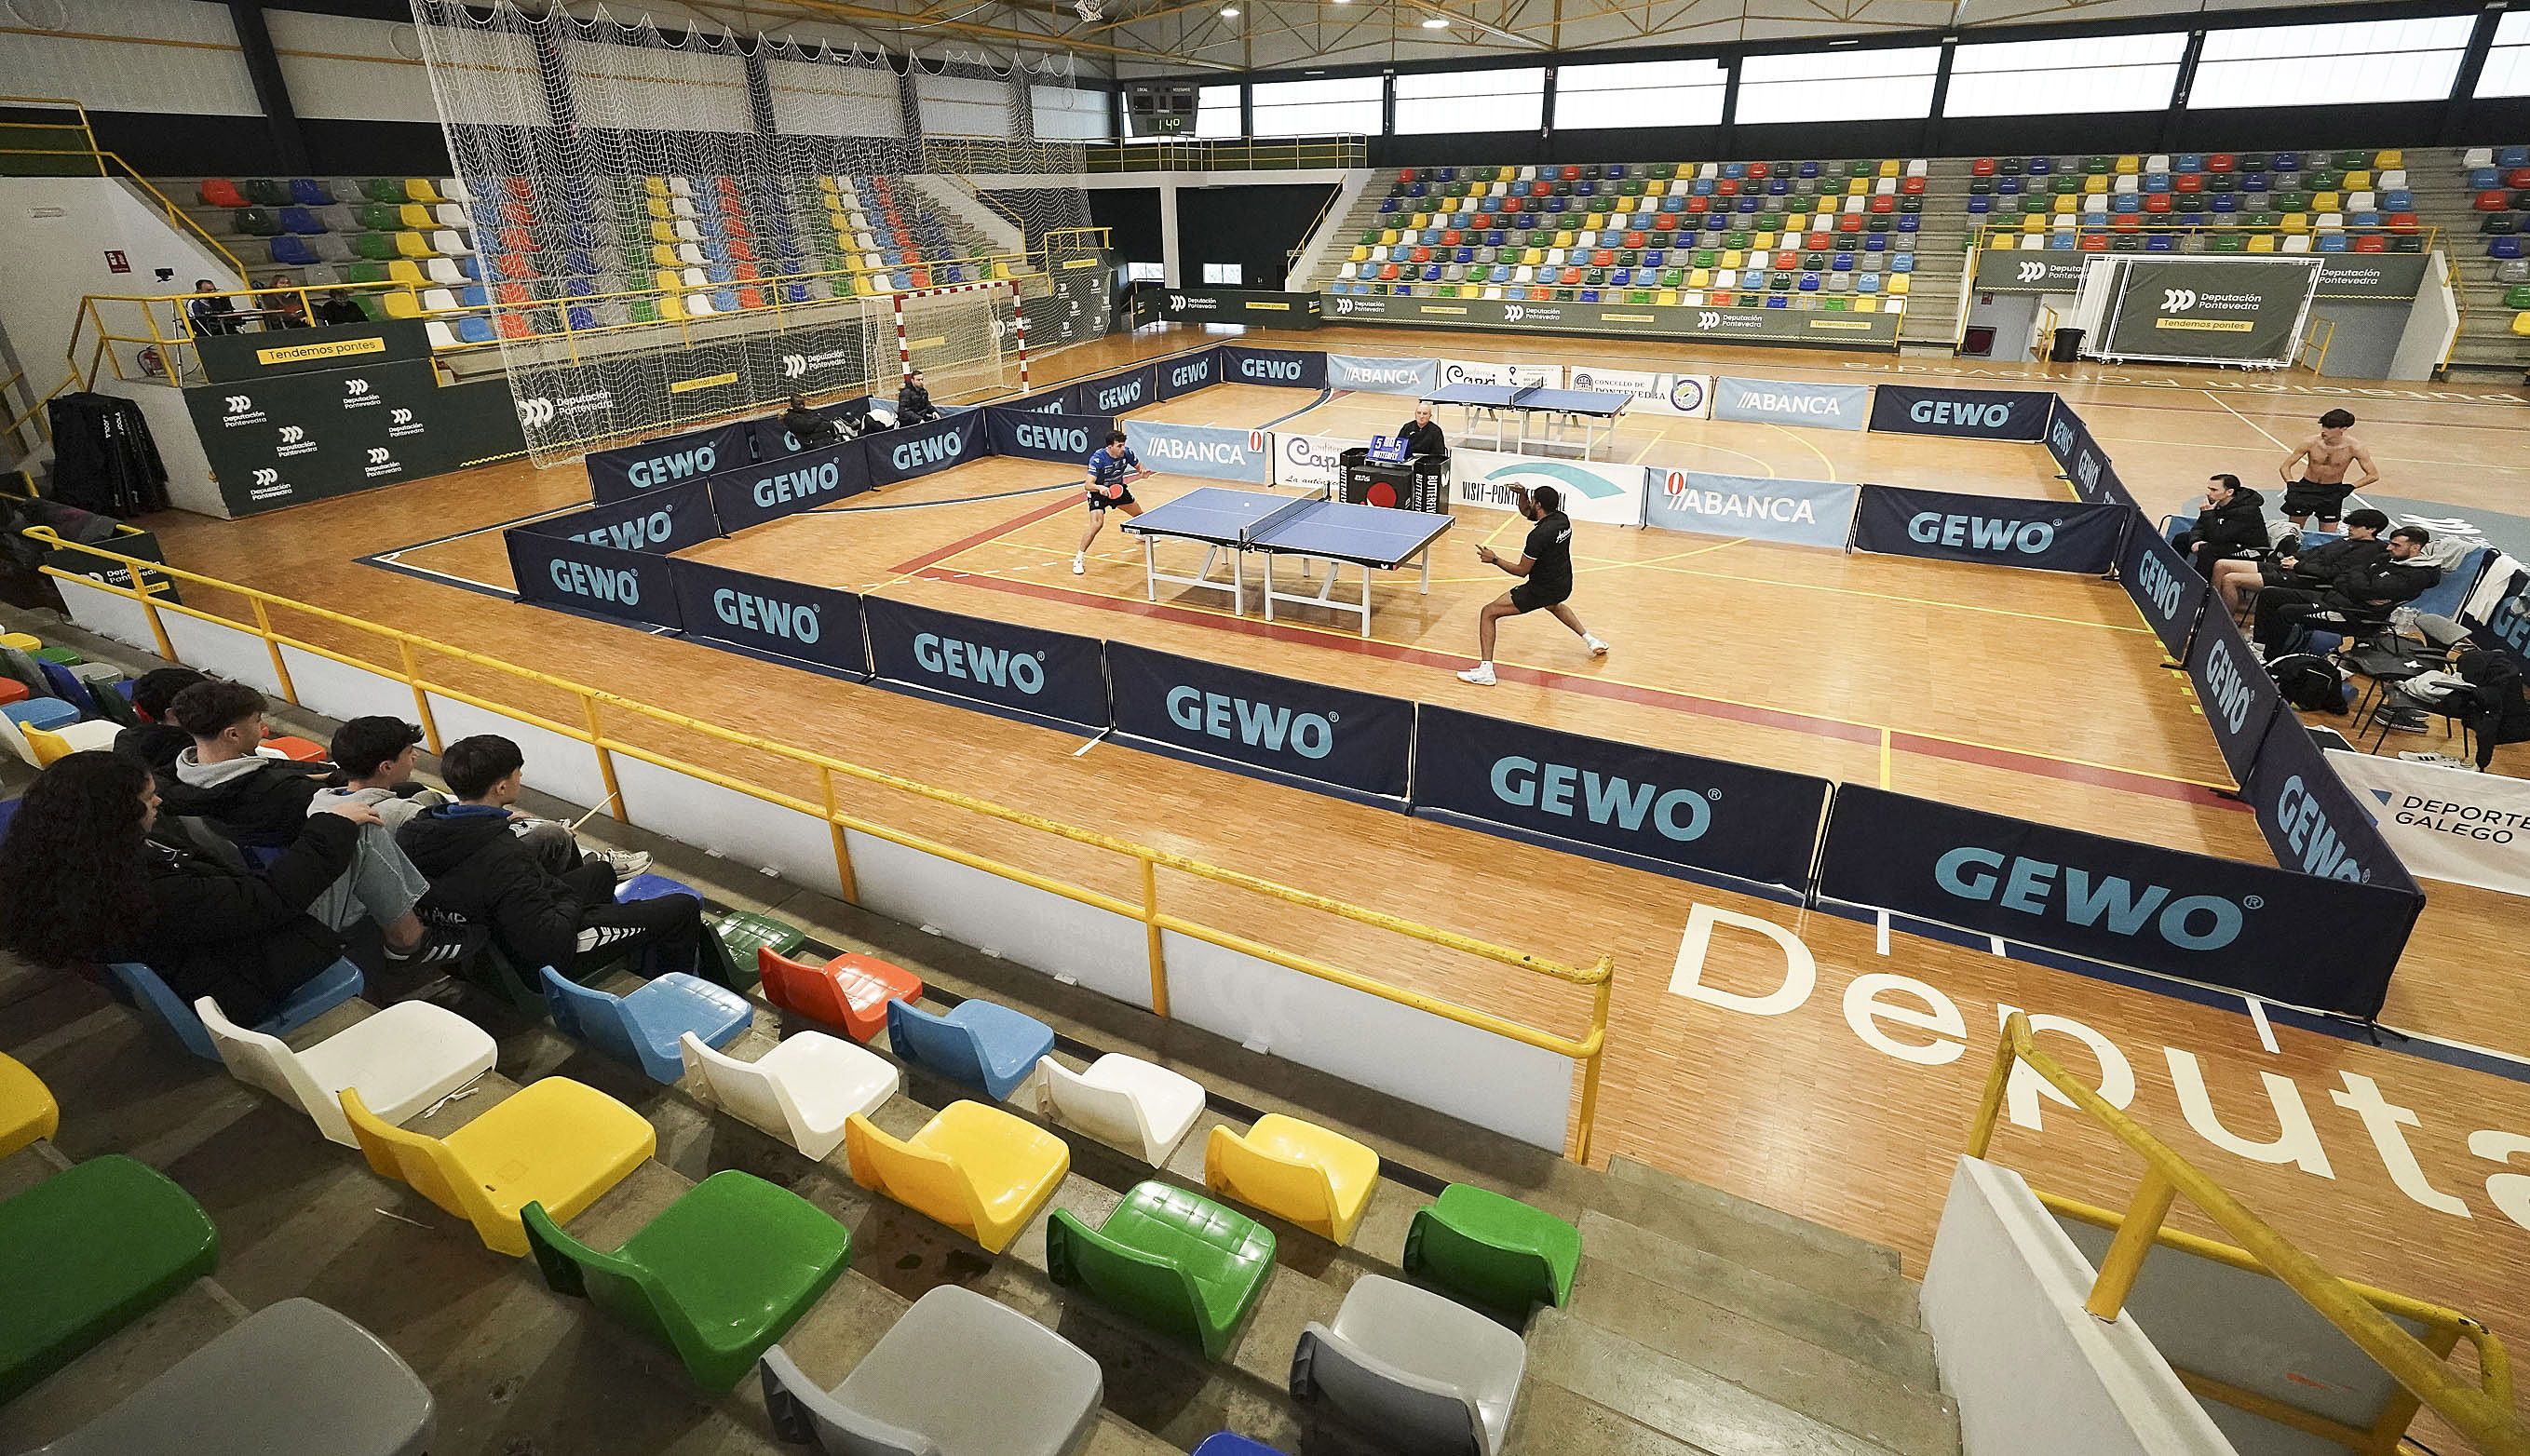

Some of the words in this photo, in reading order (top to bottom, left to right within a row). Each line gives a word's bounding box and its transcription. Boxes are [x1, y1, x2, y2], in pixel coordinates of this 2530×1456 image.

[2320, 268, 2380, 277] Deputación
[2318, 276, 2378, 285] Pontevedra
[2200, 292, 2262, 303] Deputación
[1525, 307, 1561, 316] Deputación
[2199, 301, 2260, 311] Pontevedra
[1723, 314, 1762, 322] Deputación
[2164, 319, 2211, 329] Tendemos
[2212, 321, 2245, 331] pontes
[268, 345, 333, 360] Tendemos
[336, 341, 375, 355] pontes
[1594, 379, 1632, 387] CONCELLO
[343, 393, 380, 404] Deputación
[223, 411, 265, 423] Deputación
[224, 417, 267, 428] Pontevedra
[277, 440, 317, 452] Deputación
[1374, 438, 1383, 450] 5
[1394, 439, 1402, 452] 5
[1426, 475, 1439, 514] BUTTERFLY
[567, 511, 672, 551] EWO
[2395, 812, 2514, 844] GALEGO
